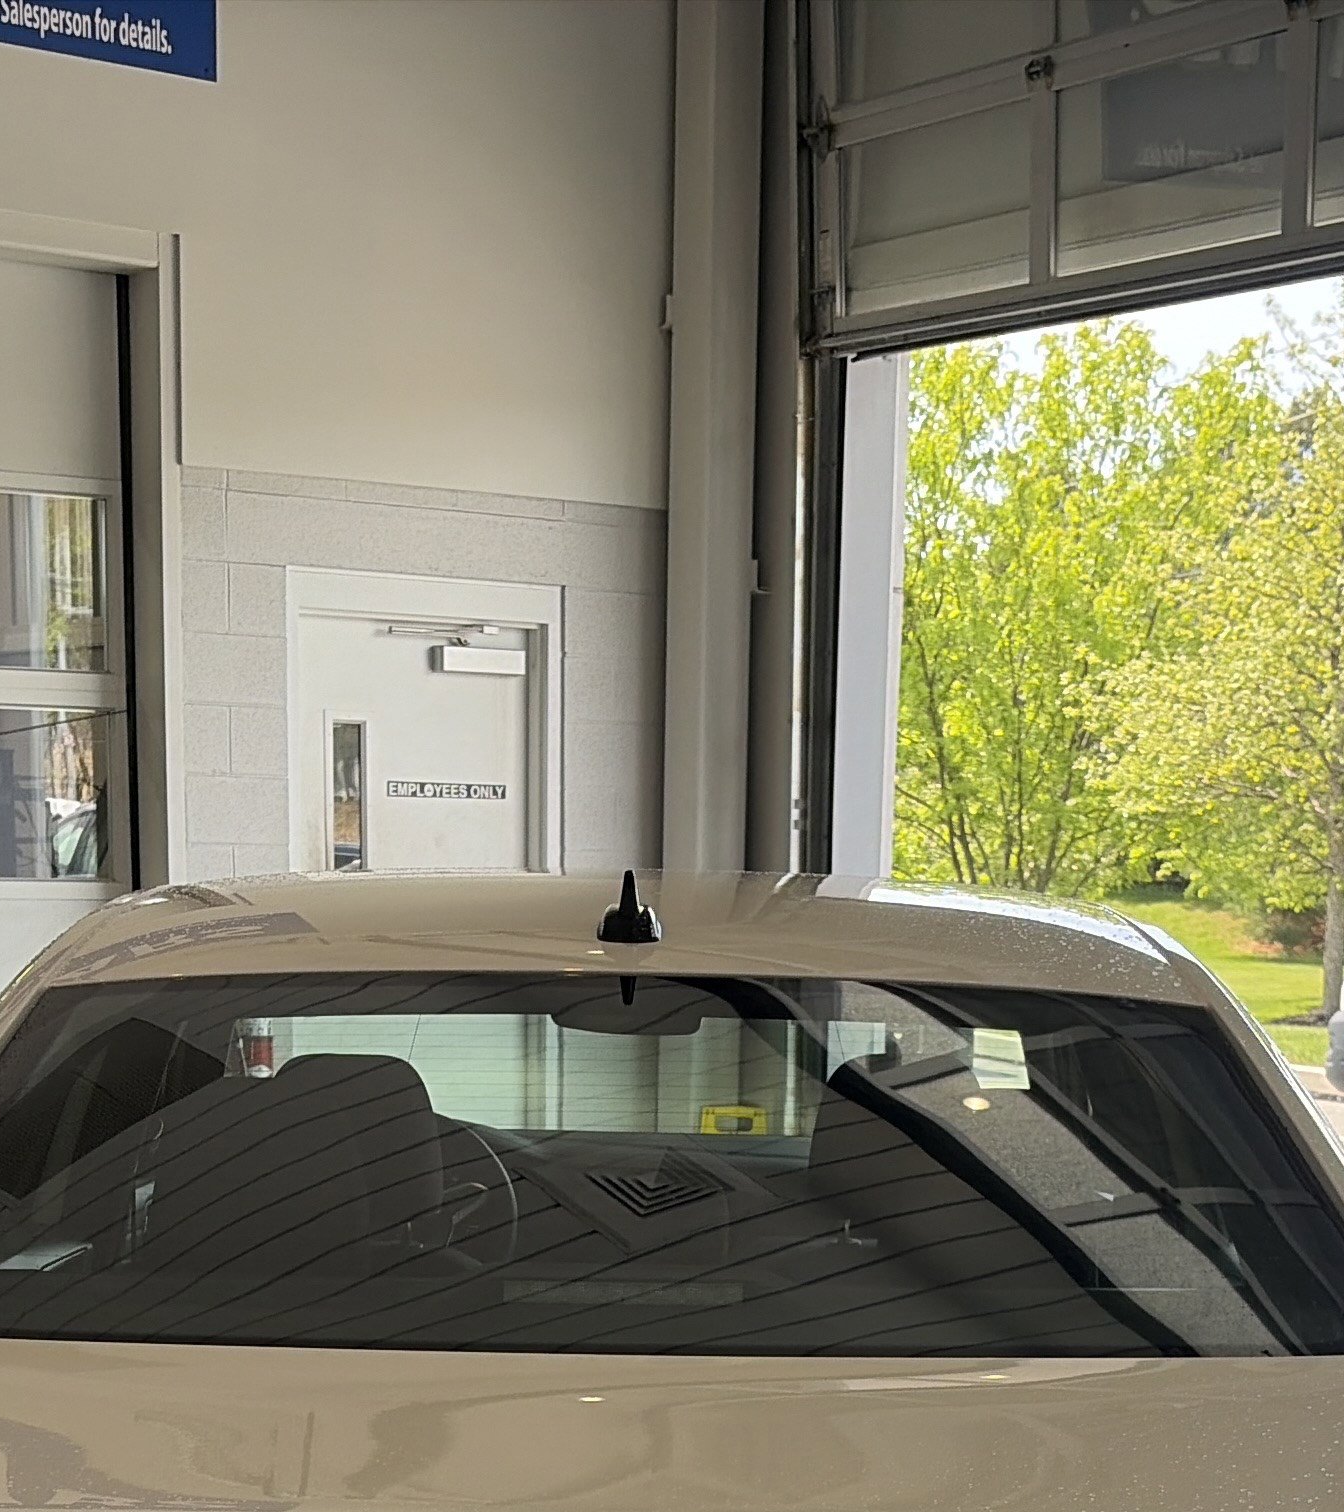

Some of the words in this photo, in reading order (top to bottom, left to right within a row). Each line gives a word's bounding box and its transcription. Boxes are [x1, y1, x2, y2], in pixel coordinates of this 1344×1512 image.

[0, 0, 92, 39] Salesperson
[94, 7, 117, 43] for
[119, 13, 172, 54] details.
[388, 782, 468, 798] EMPLOYEES
[470, 785, 504, 799] ONLY
